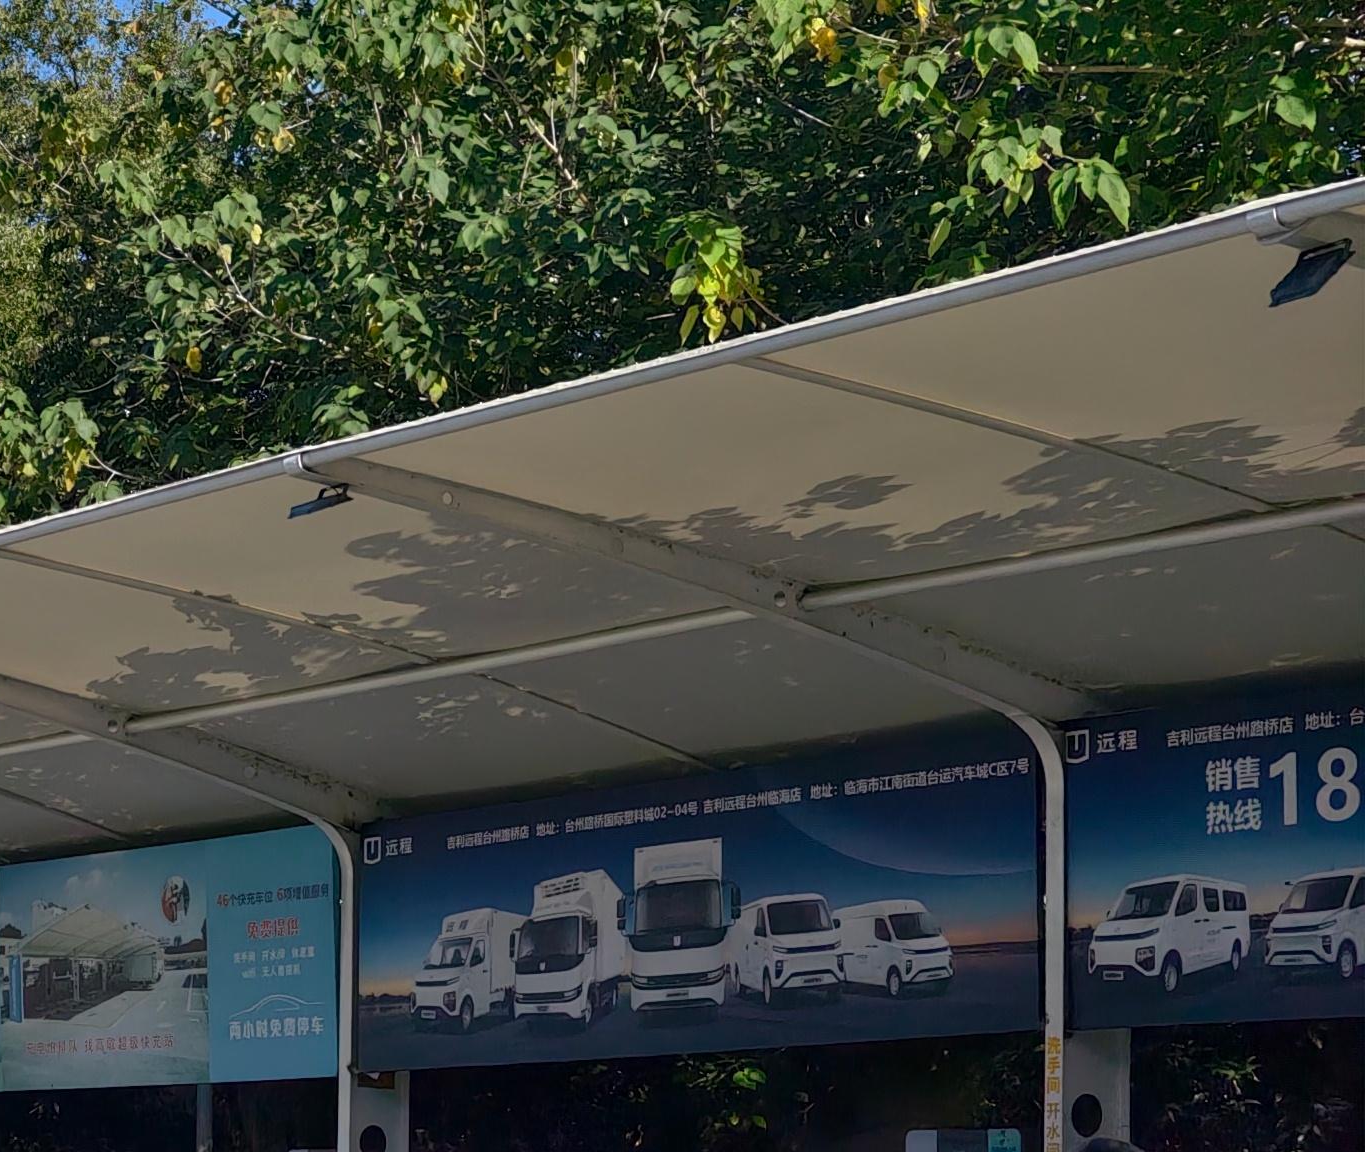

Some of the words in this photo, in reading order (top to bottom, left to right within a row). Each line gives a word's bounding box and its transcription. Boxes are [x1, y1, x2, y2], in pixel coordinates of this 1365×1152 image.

[1097, 730, 1137, 753] 远程
[1166, 716, 1294, 748] 吉利远程台州路桥店
[1205, 755, 1261, 793] 销售
[1205, 798, 1262, 835] 热线
[385, 837, 413, 857] 远程
[446, 826, 530, 850] 吉利远程台州路桥店
[247, 917, 299, 939] 免费提供
[229, 1016, 325, 1041] 两小时免费停车
